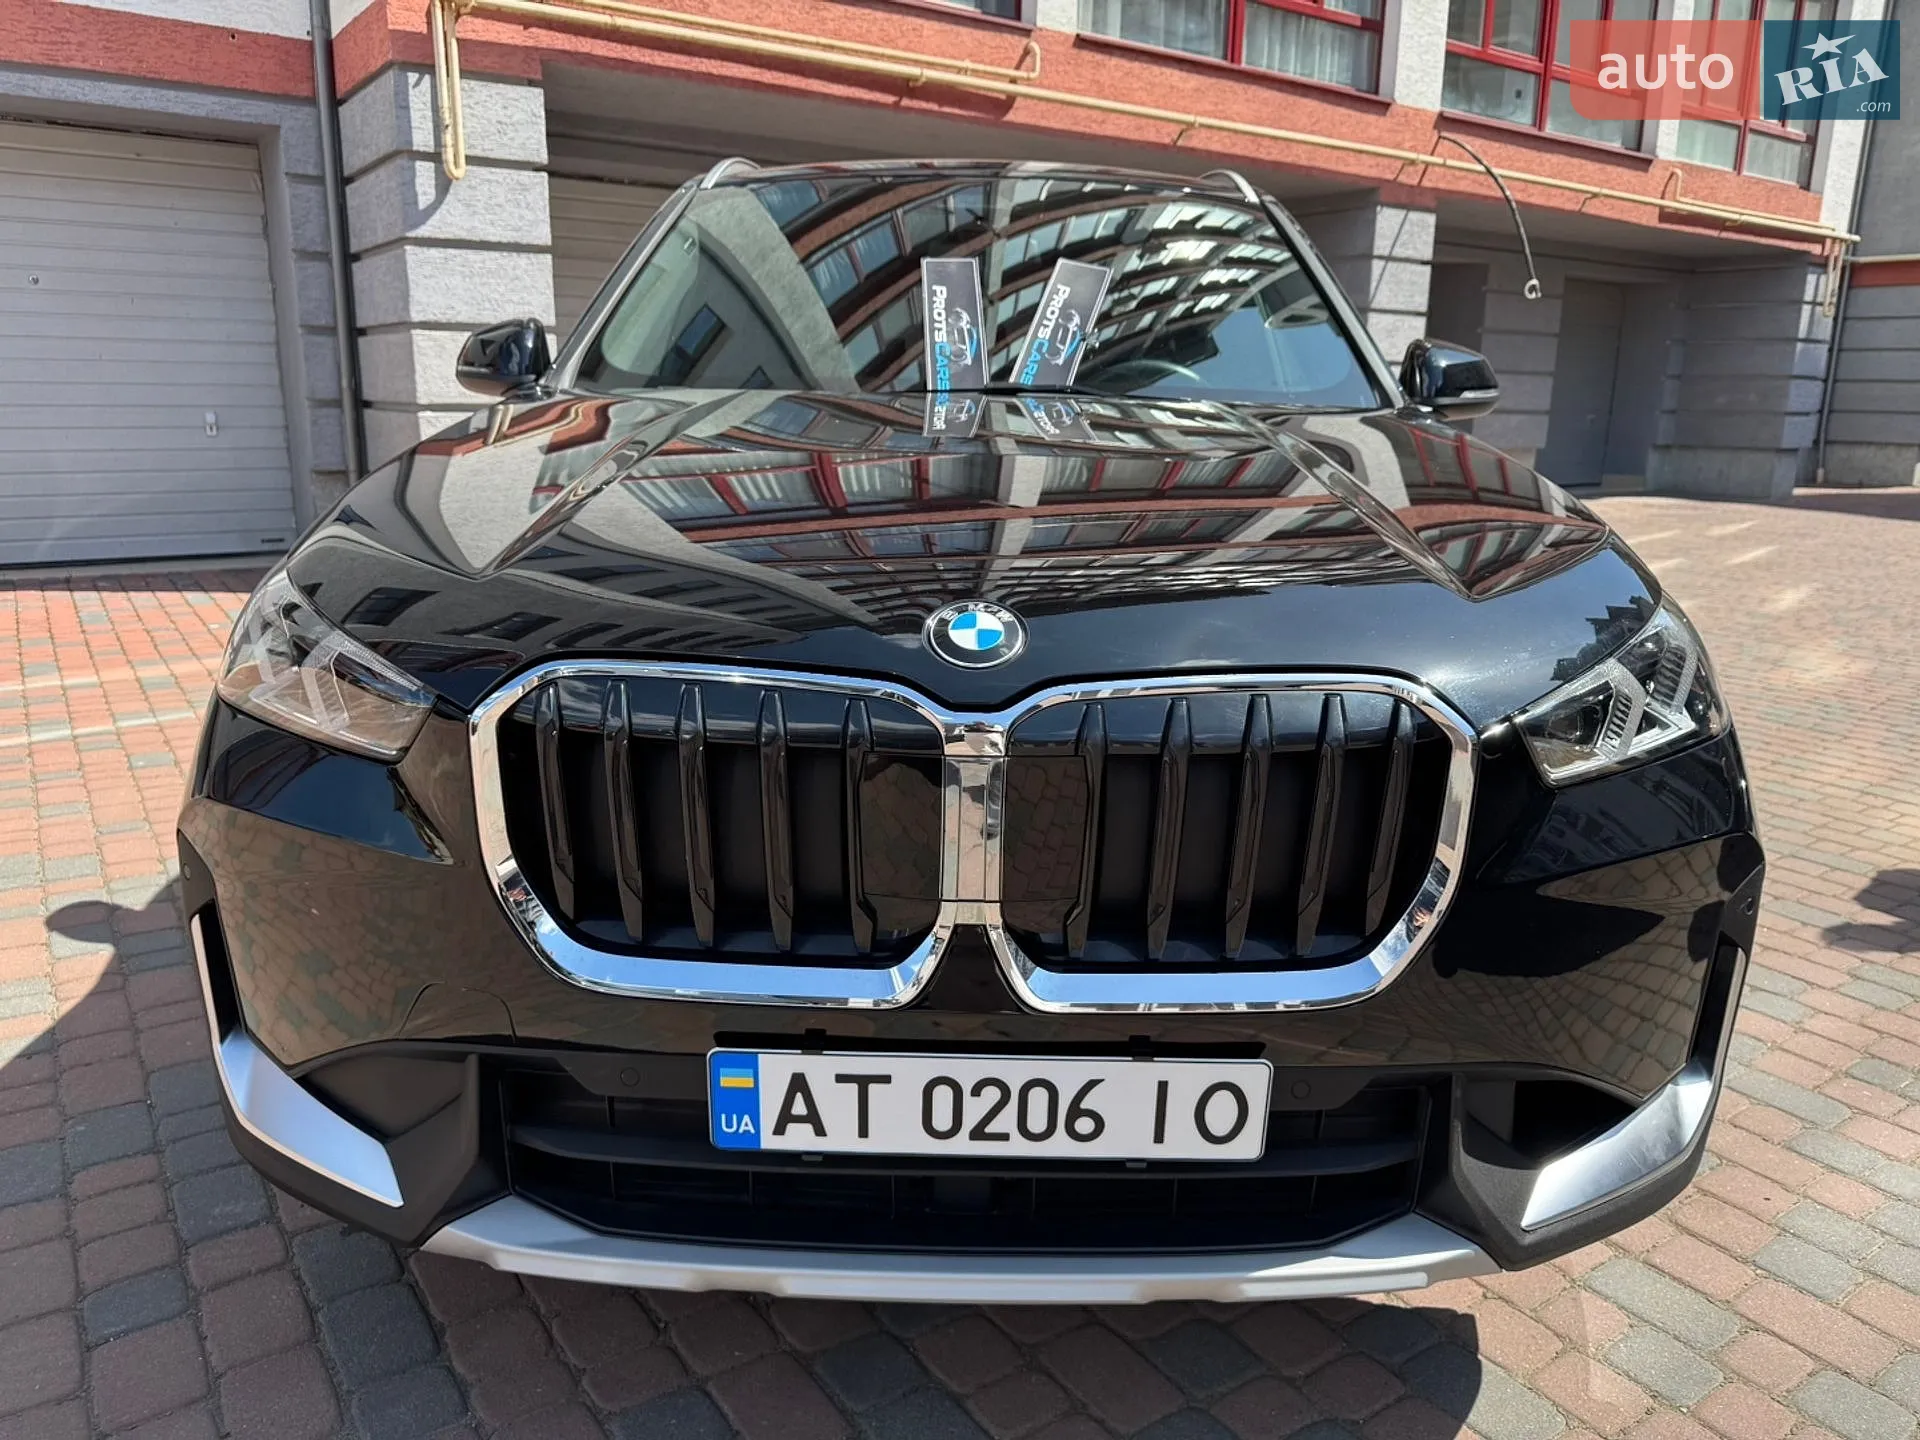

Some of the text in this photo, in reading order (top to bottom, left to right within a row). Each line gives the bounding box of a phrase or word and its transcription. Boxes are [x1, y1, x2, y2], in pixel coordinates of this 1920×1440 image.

[939, 602, 1017, 622] BMW
[772, 1071, 1250, 1145] AT 0206 IO
[721, 1112, 755, 1134] UA
